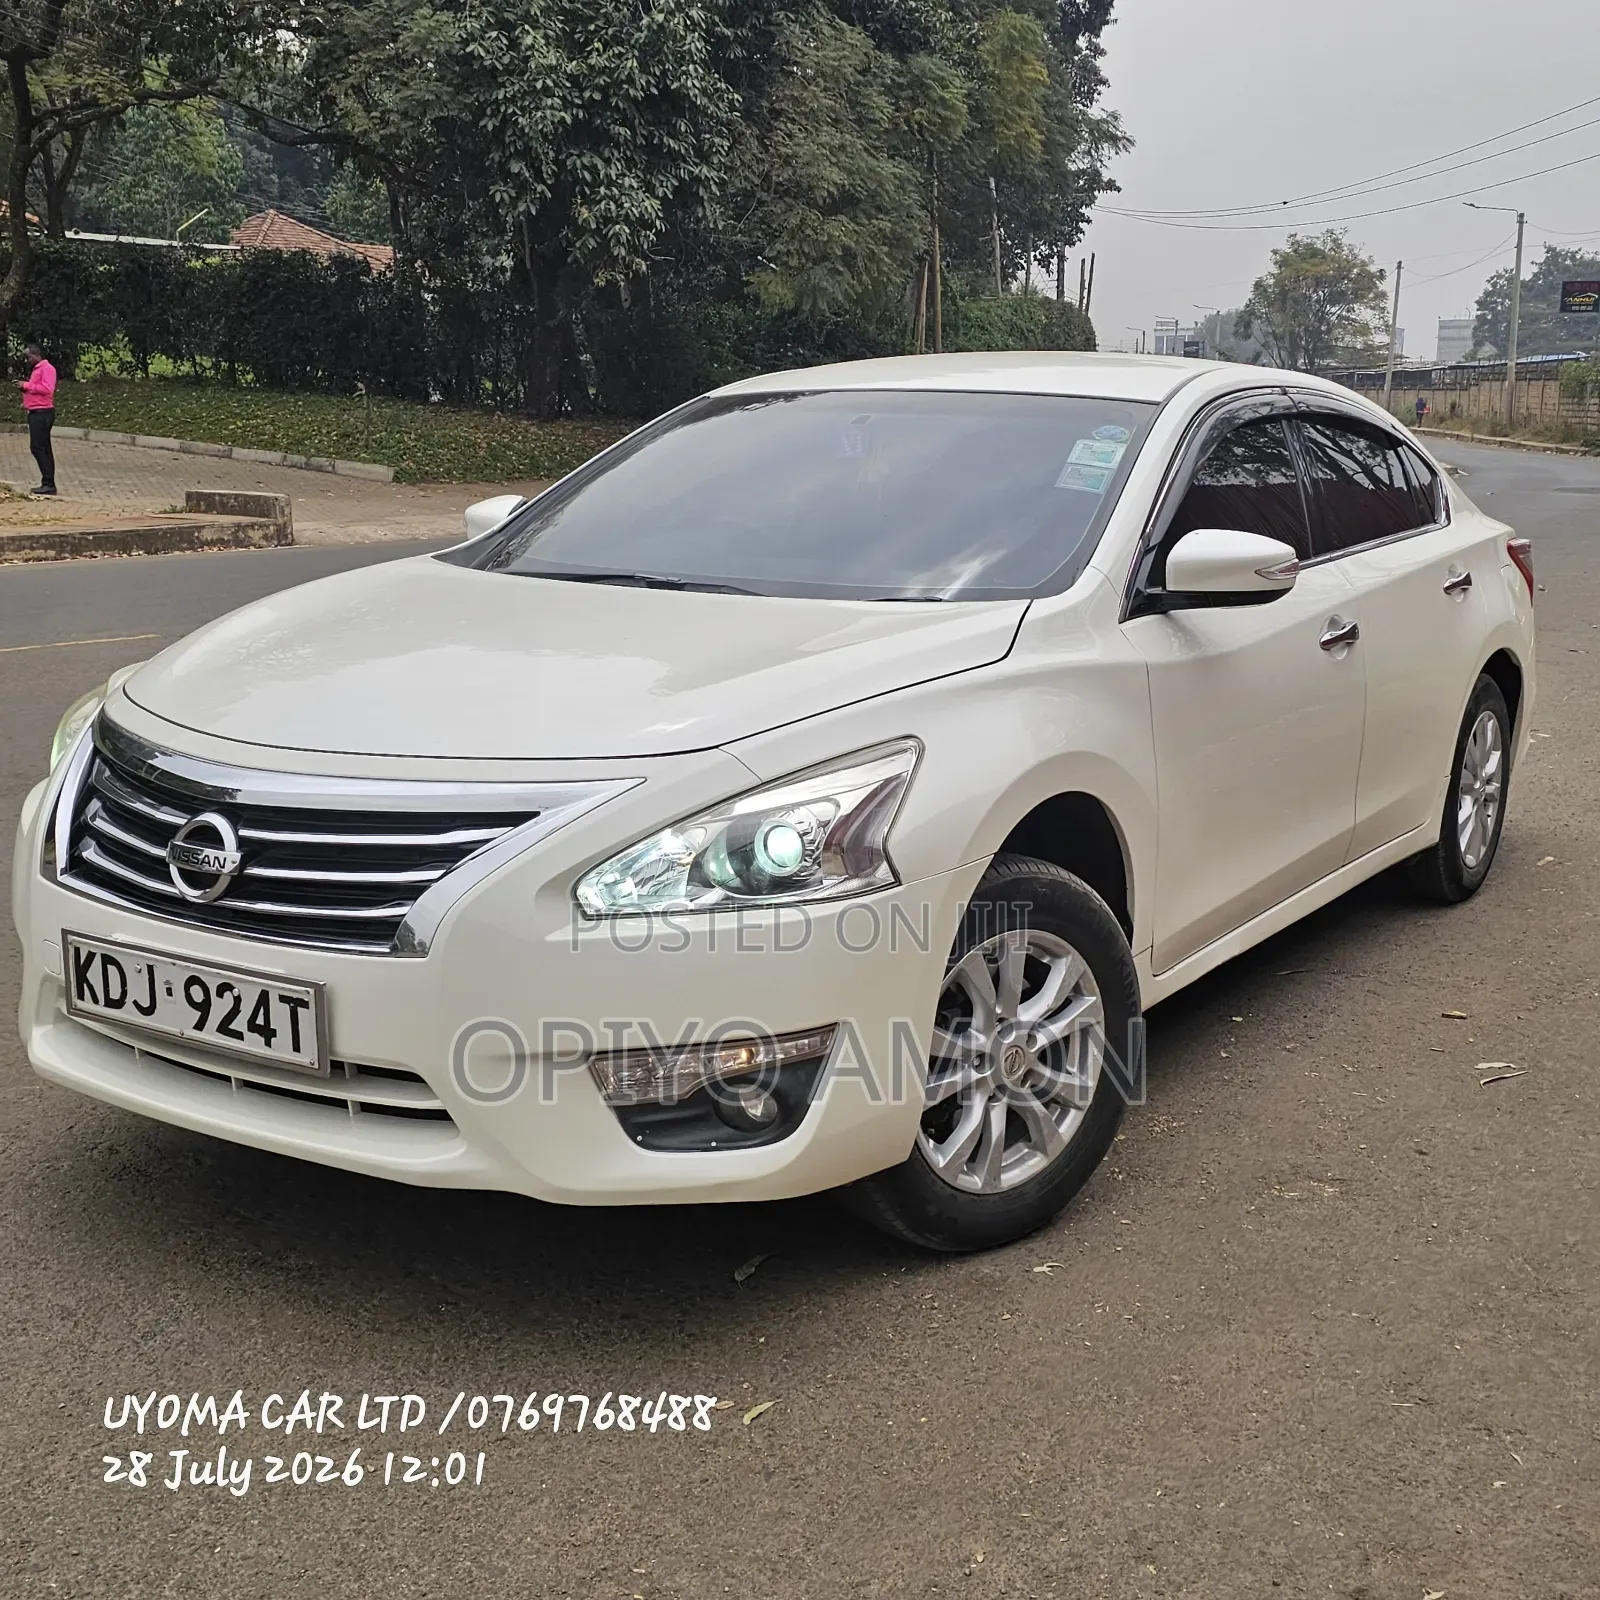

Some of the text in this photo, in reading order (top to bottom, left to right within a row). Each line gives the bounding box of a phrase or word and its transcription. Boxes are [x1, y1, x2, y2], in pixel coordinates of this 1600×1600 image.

[169, 847, 227, 870] NISSAN
[73, 945, 310, 1054] KDJ 924T
